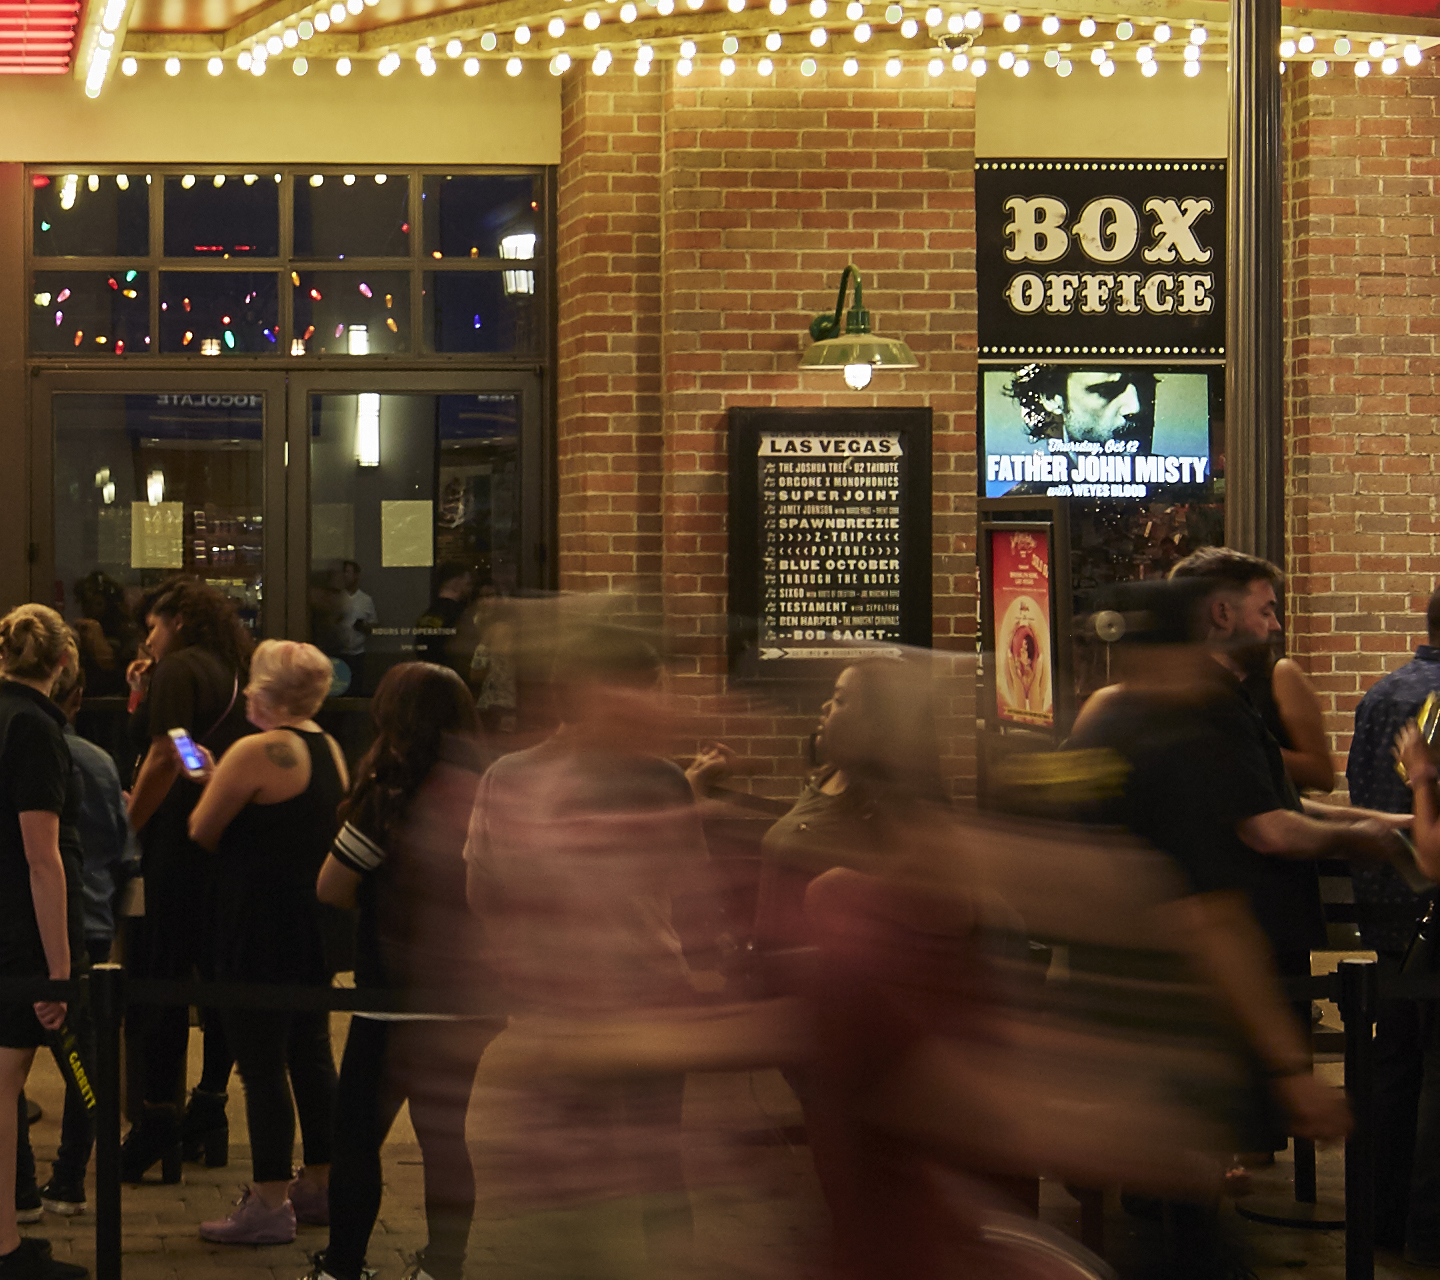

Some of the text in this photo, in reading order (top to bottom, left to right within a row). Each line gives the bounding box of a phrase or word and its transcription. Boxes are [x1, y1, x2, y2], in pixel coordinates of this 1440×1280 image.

[1003, 195, 1213, 264] BOX
[1005, 271, 1214, 315] OFFICE
[771, 440, 891, 453] LAS VEGAS
[1048, 438, 1104, 454] Thursday,
[1105, 439, 1125, 453] Oct
[779, 463, 794, 473] THE
[796, 463, 826, 473] JOSHUA
[987, 455, 1208, 483] FATHER JOHN MISTY
[779, 477, 822, 487] ORGONE
[834, 477, 899, 487] MONOPHONICS
[779, 491, 899, 501] SUPERJOINT
[1047, 485, 1072, 497] with
[1072, 484, 1110, 497] WEYES
[779, 518, 899, 529] SPAWNBREEZIE
[779, 560, 900, 570] BLUE OCTOBER
[780, 574, 900, 584] THROUGH THE ROOTS
[780, 602, 847, 612] TESTAMENT
[69, 1050, 96, 1109] GARRETT
